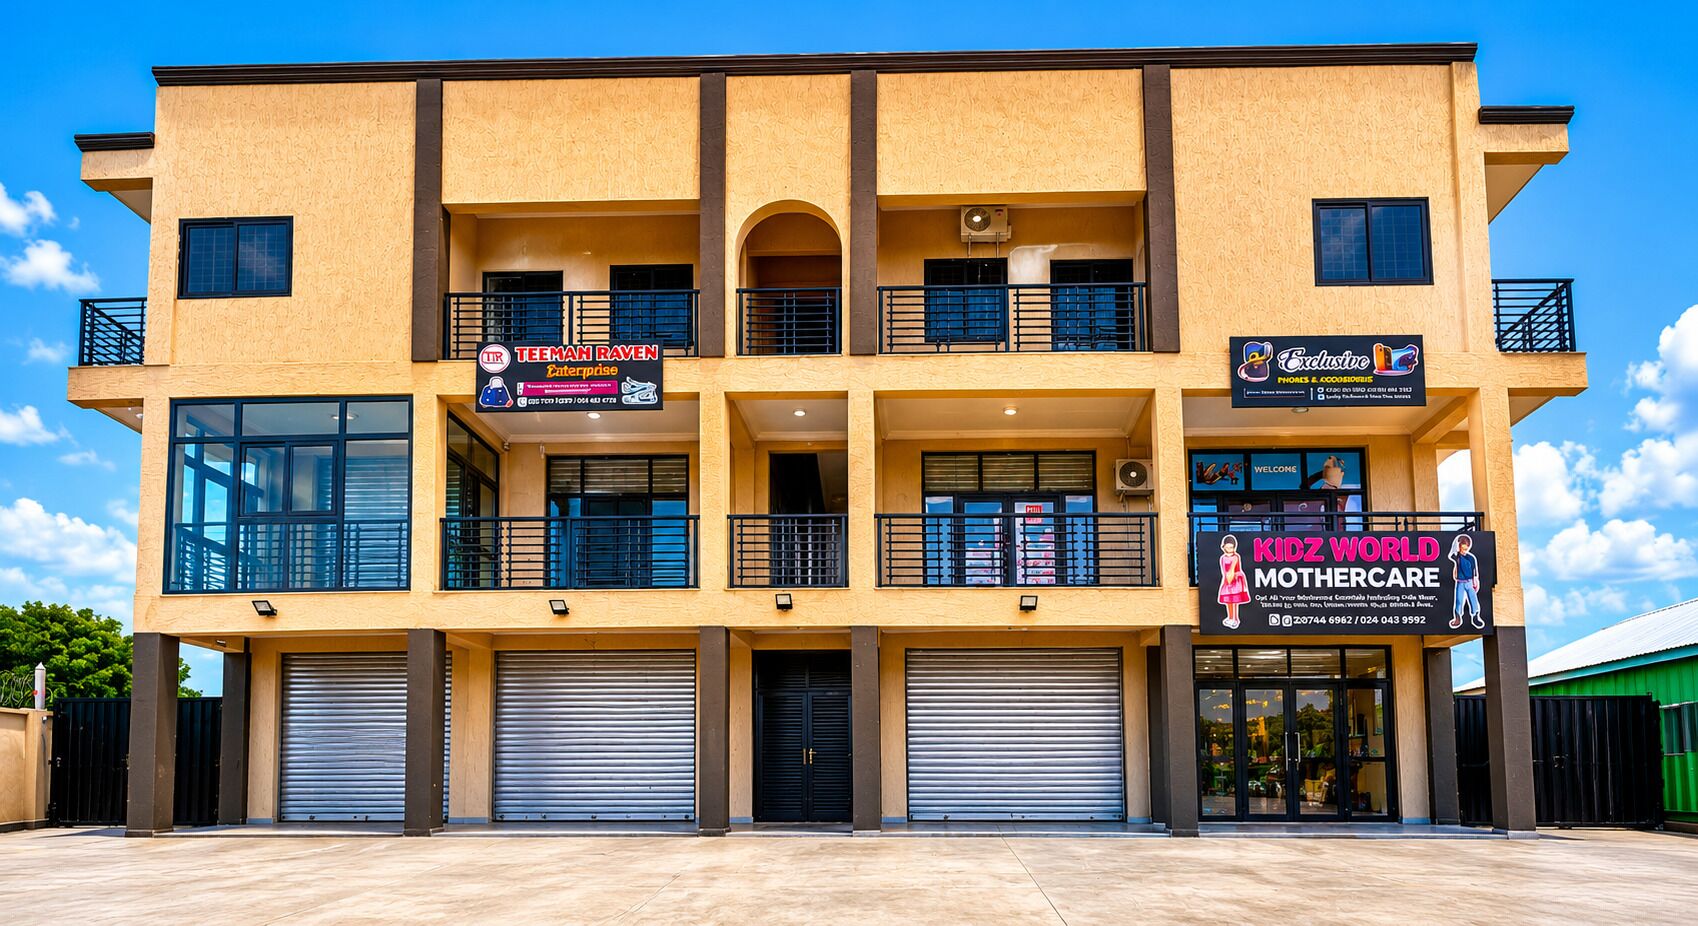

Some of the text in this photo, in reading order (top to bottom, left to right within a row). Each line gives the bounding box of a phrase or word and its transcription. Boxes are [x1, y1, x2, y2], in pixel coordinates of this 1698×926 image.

[515, 345, 659, 362] TEEMAN RAVEN
[1277, 347, 1371, 373] Exclusive
[1254, 465, 1297, 474] WELCOME
[1253, 536, 1441, 562] KIDZ WORLD
[1254, 567, 1441, 588] MOTHERCARE
[1360, 616, 1379, 625] 024
[1380, 616, 1400, 625] 043
